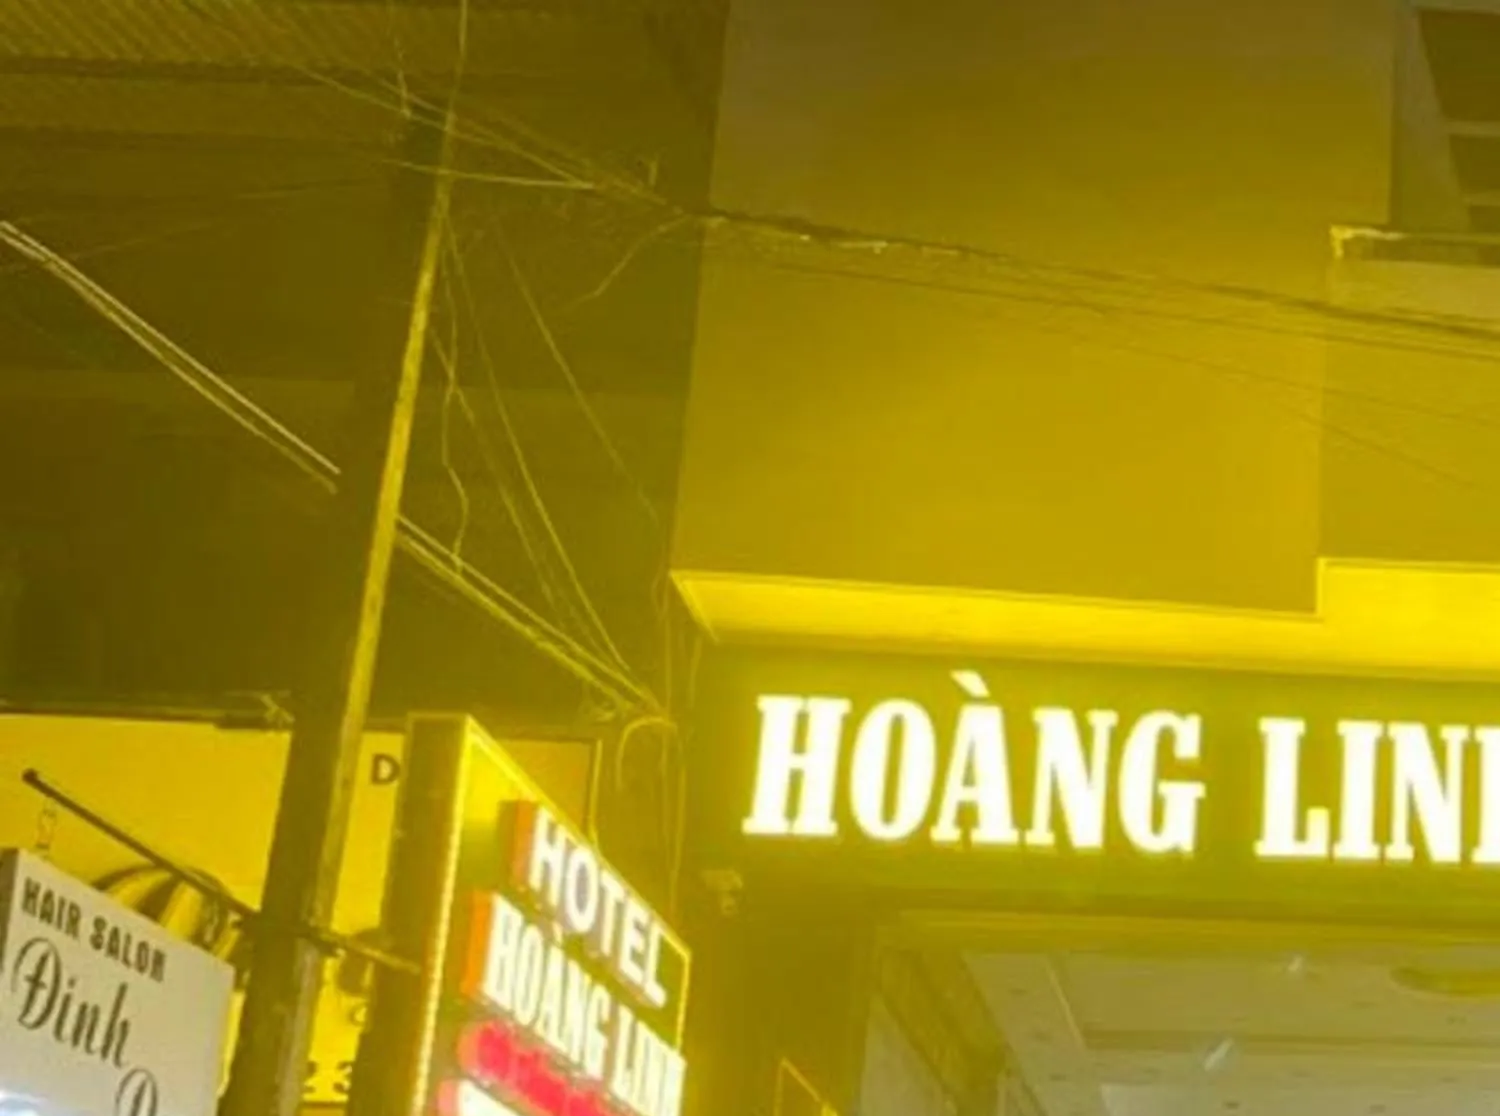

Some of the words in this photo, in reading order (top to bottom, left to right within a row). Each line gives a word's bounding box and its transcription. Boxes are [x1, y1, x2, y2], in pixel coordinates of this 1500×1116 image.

[741, 670, 1205, 854] HOÀNG
[20, 876, 83, 941] HAIR
[90, 915, 168, 983] SALON
[522, 803, 667, 1008] HOTEL
